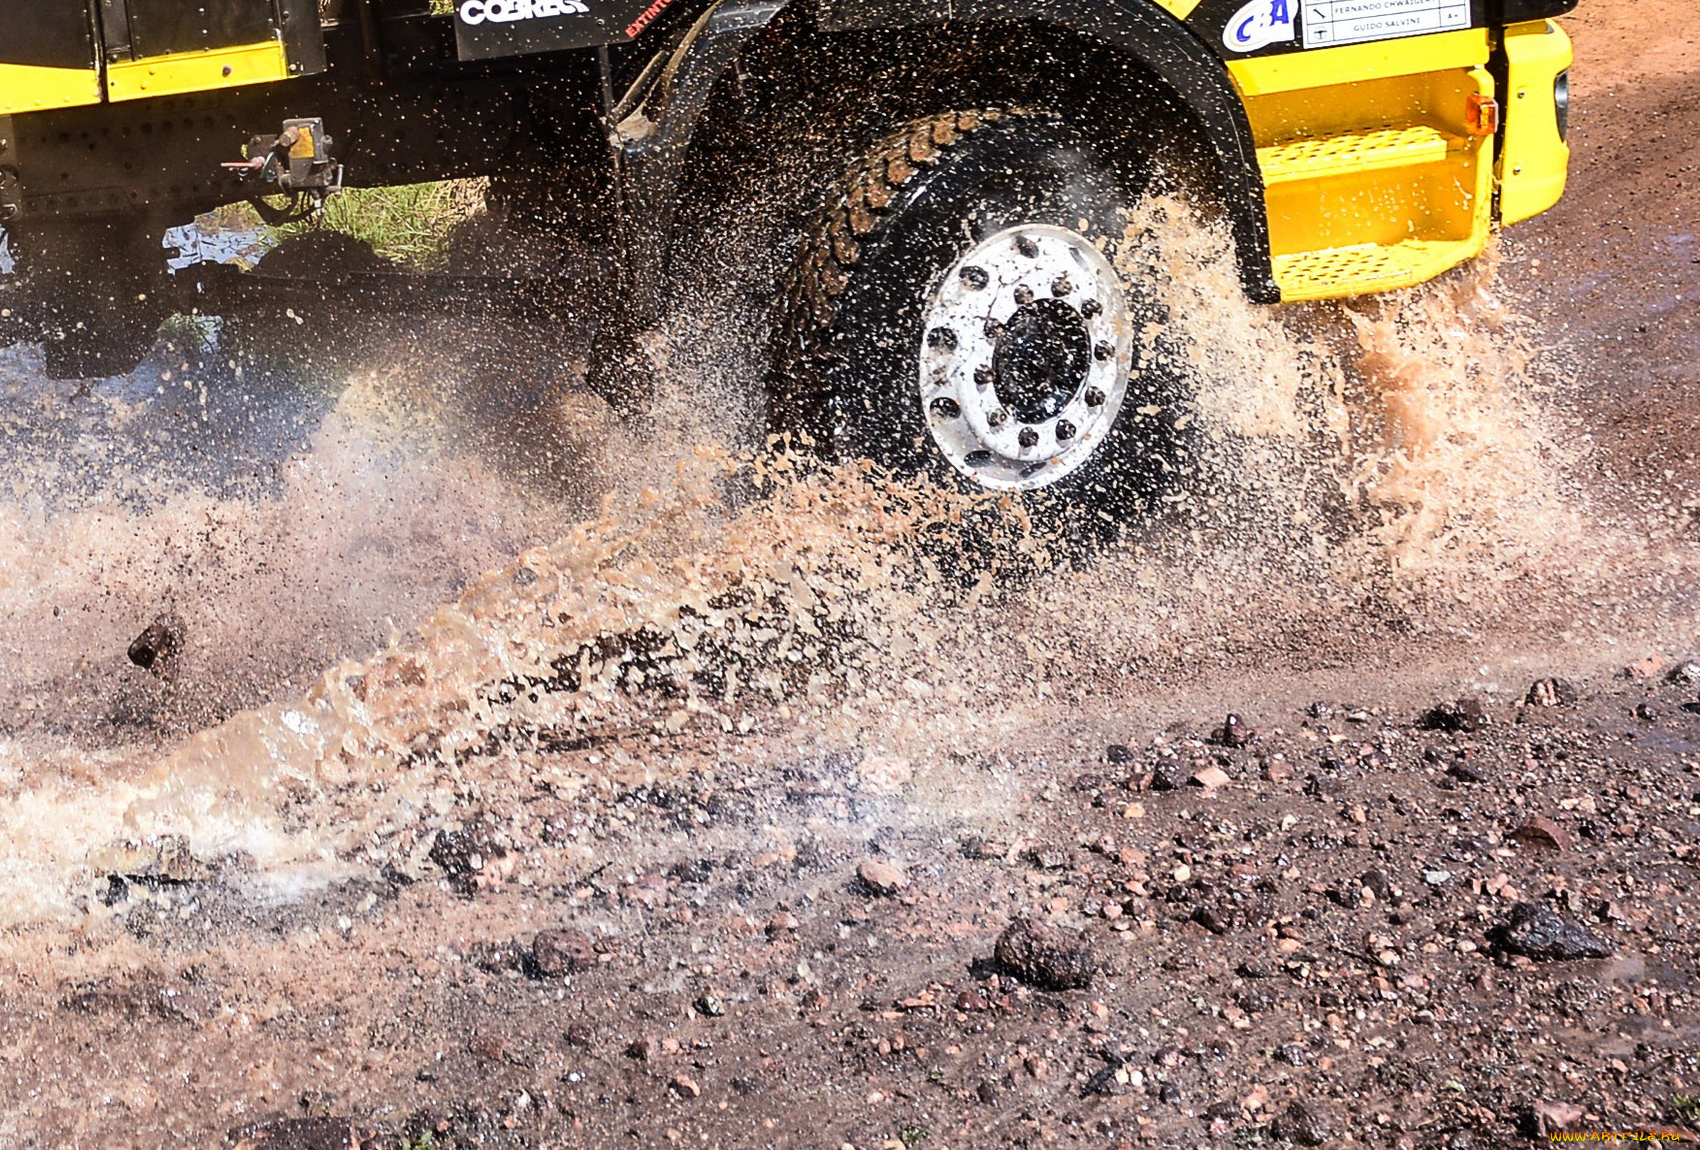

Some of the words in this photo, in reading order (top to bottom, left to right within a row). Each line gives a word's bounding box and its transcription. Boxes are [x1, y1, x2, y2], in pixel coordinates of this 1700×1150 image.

[1334, 1, 1382, 15] FERNANDO
[1353, 20, 1383, 33] GUIDO
[1385, 16, 1421, 29] SALVINI
